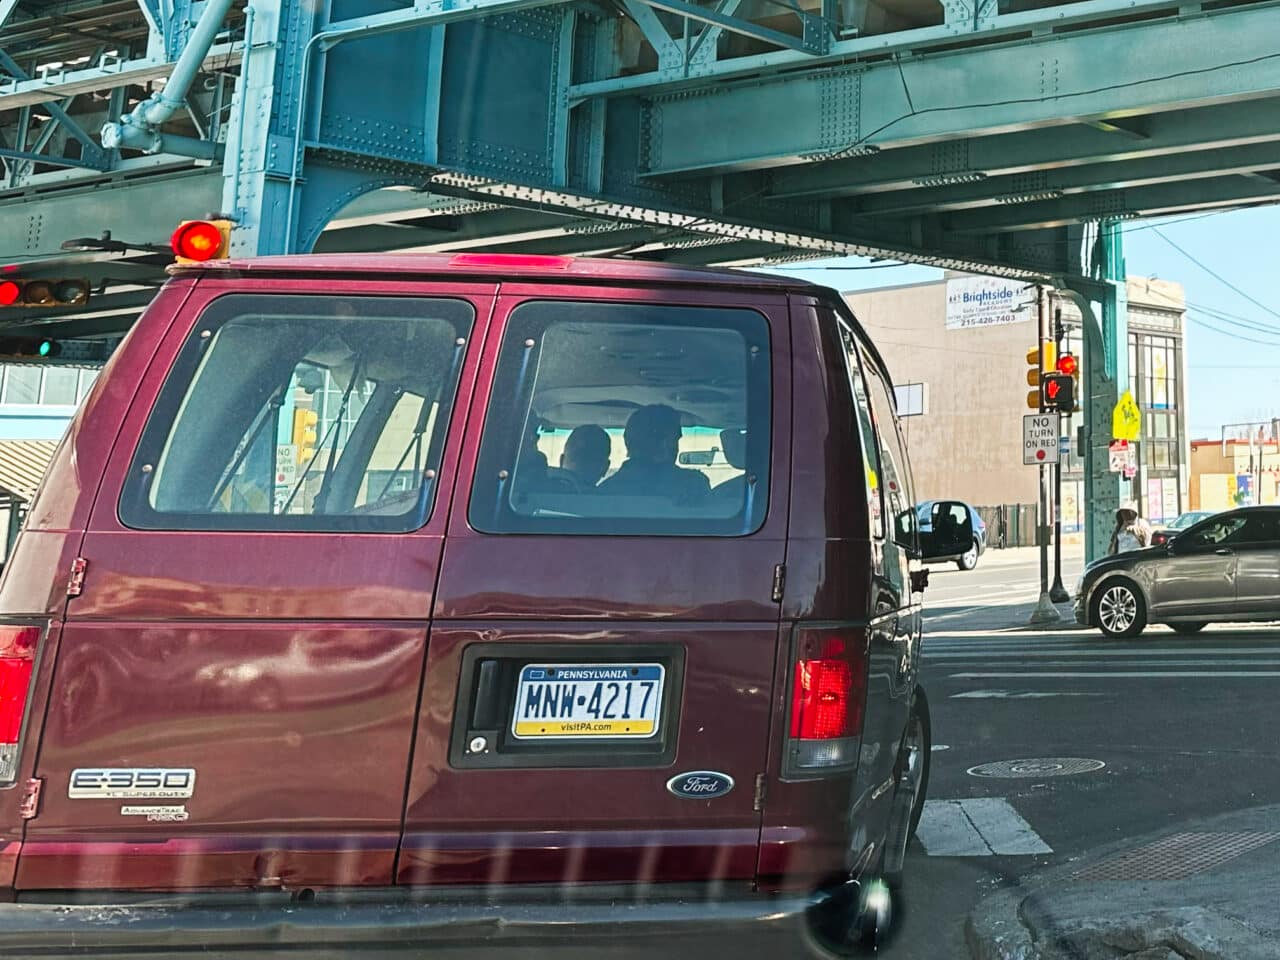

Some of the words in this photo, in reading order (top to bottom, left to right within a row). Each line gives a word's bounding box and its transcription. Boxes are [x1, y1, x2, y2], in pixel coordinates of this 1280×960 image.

[963, 286, 1013, 306] Brightside
[1032, 417, 1049, 428] NO
[1029, 428, 1054, 438] TURN
[1026, 440, 1038, 449] ON
[1040, 439, 1056, 447] RED
[278, 448, 290, 457] NO
[279, 457, 291, 465] URN
[557, 670, 628, 679] PENNSYLVANIA
[560, 721, 612, 732] visitPA.com
[683, 776, 719, 792] Ford
